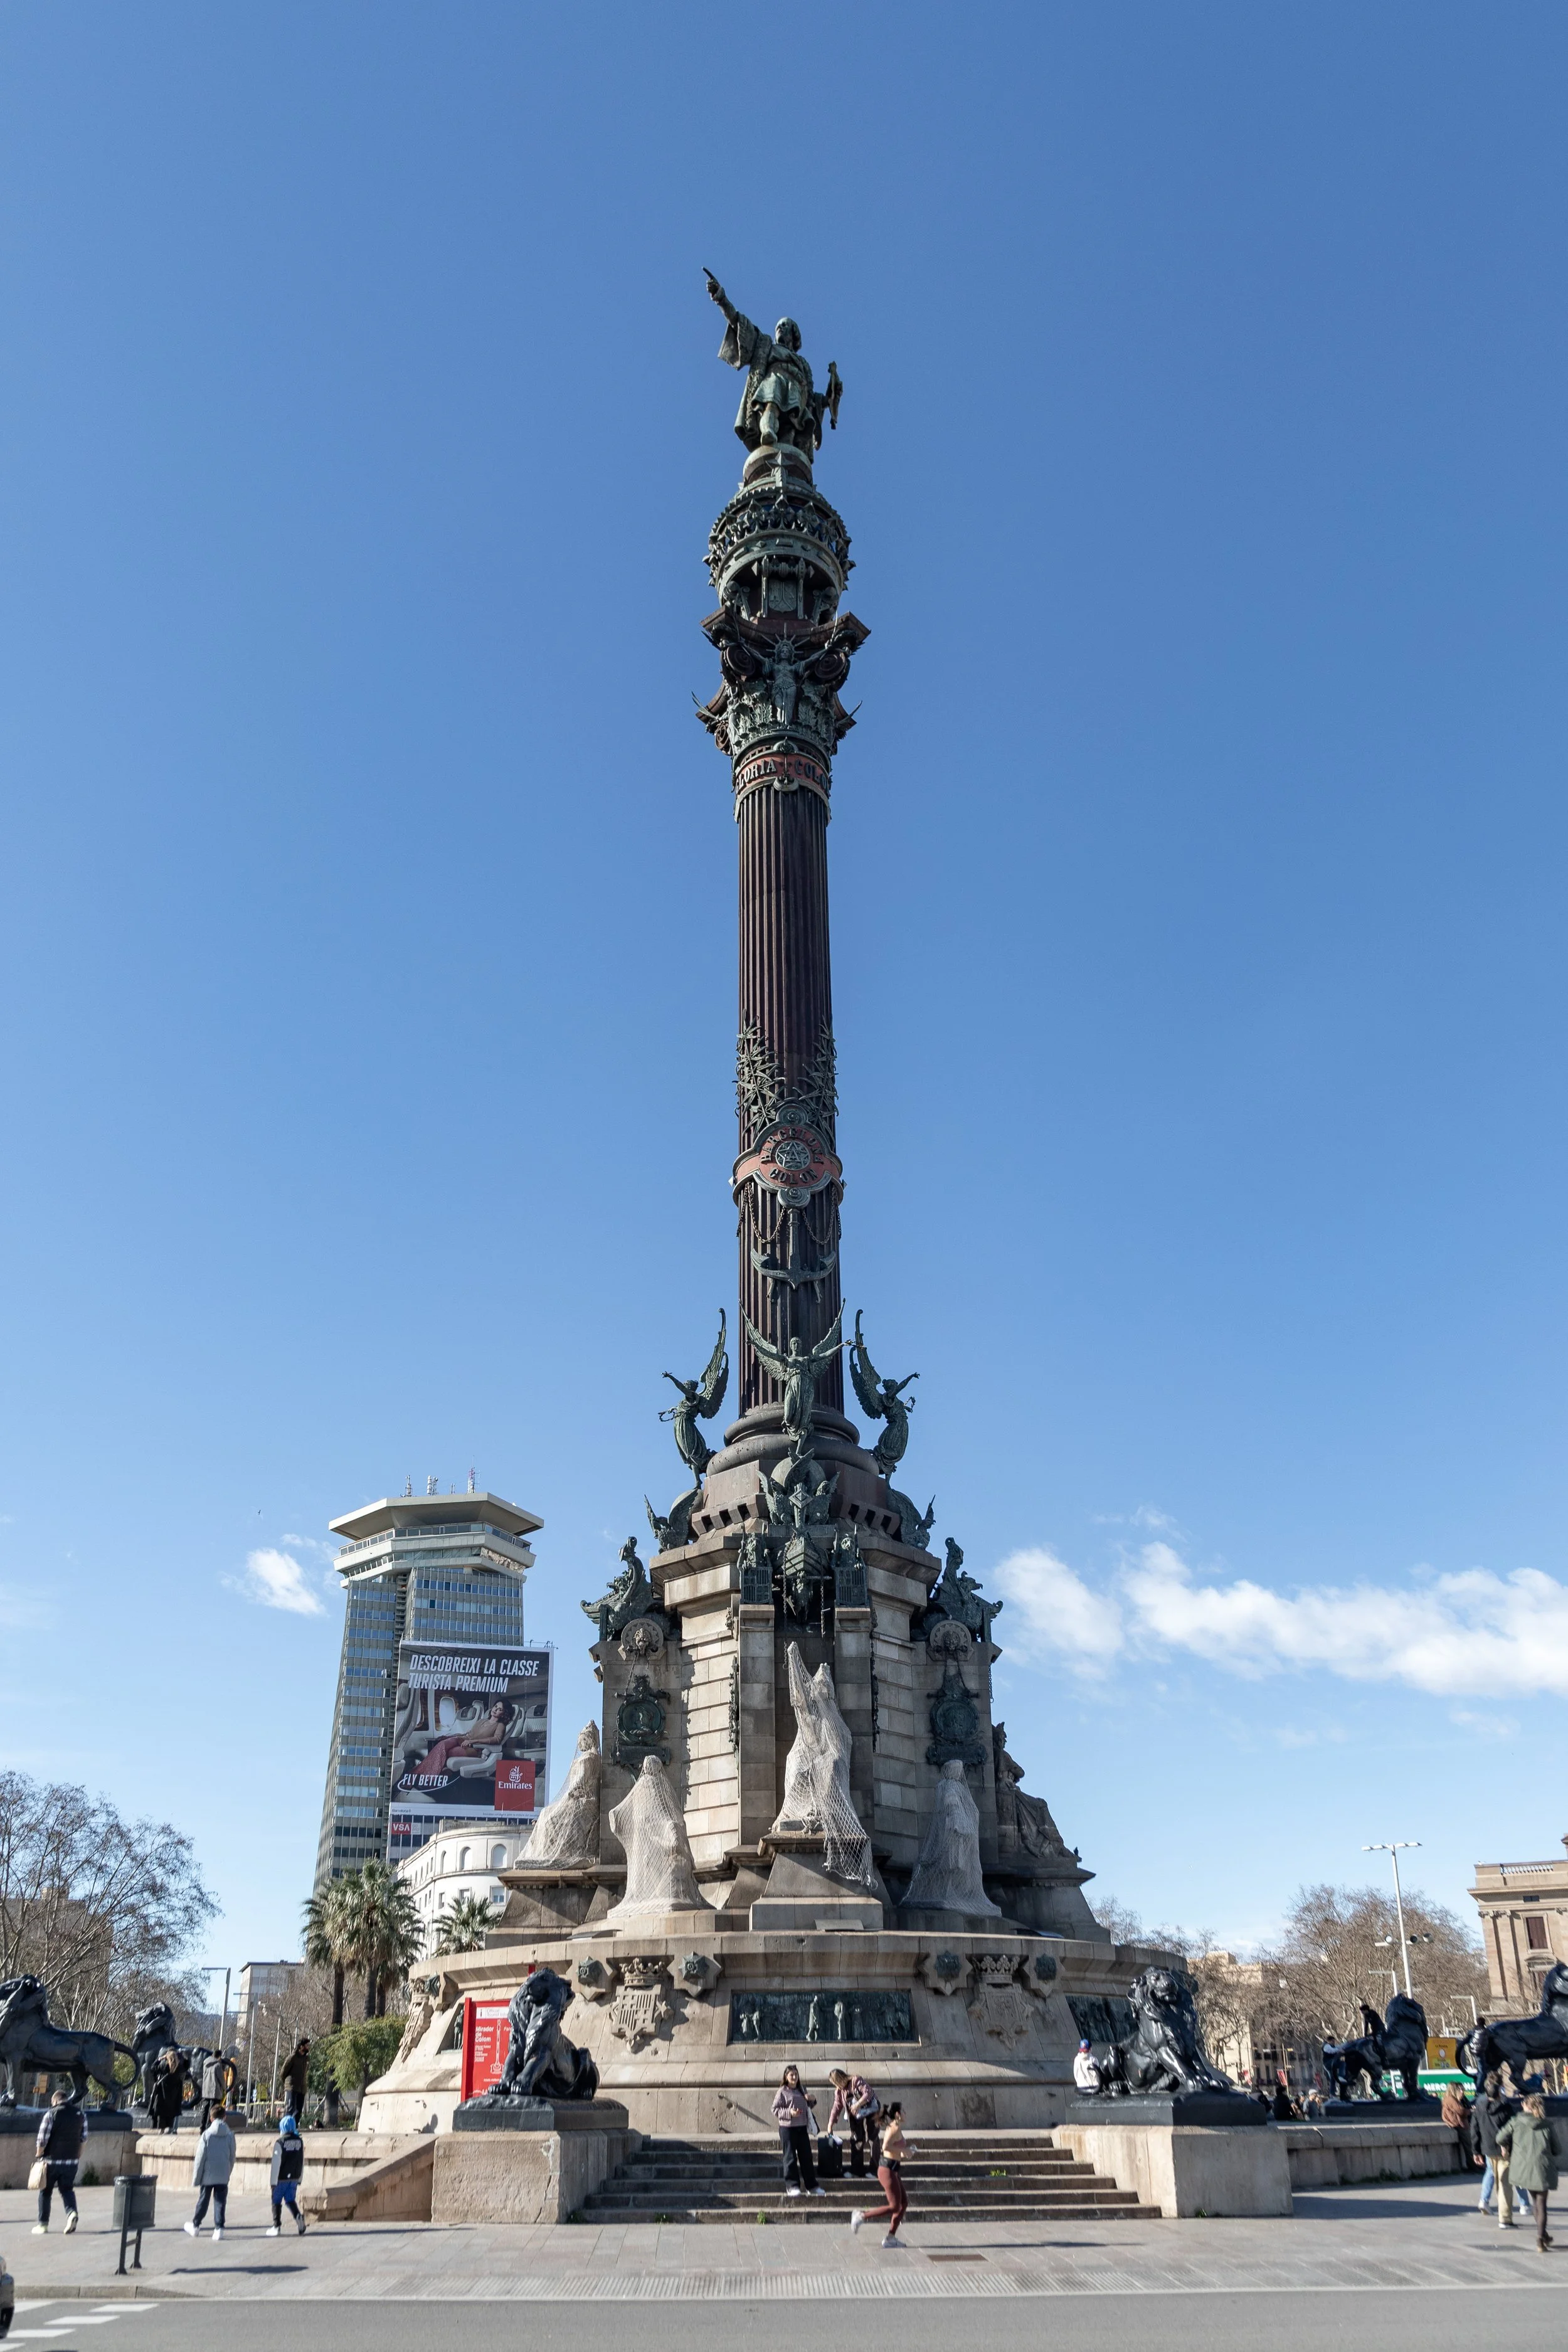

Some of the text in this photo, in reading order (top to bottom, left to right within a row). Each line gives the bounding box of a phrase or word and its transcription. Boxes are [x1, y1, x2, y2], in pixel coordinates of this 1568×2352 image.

[735, 758, 776, 794] GLORIA
[761, 1126, 824, 1164] BARCELONA
[769, 1168, 818, 1184] COLON
[410, 1655, 539, 1677] DESCOBREIXI LA CLASSE
[408, 1673, 509, 1693] TURISTA PREMIUM
[402, 1774, 448, 1787] FLY BETTER
[498, 1781, 532, 1789] Emirates
